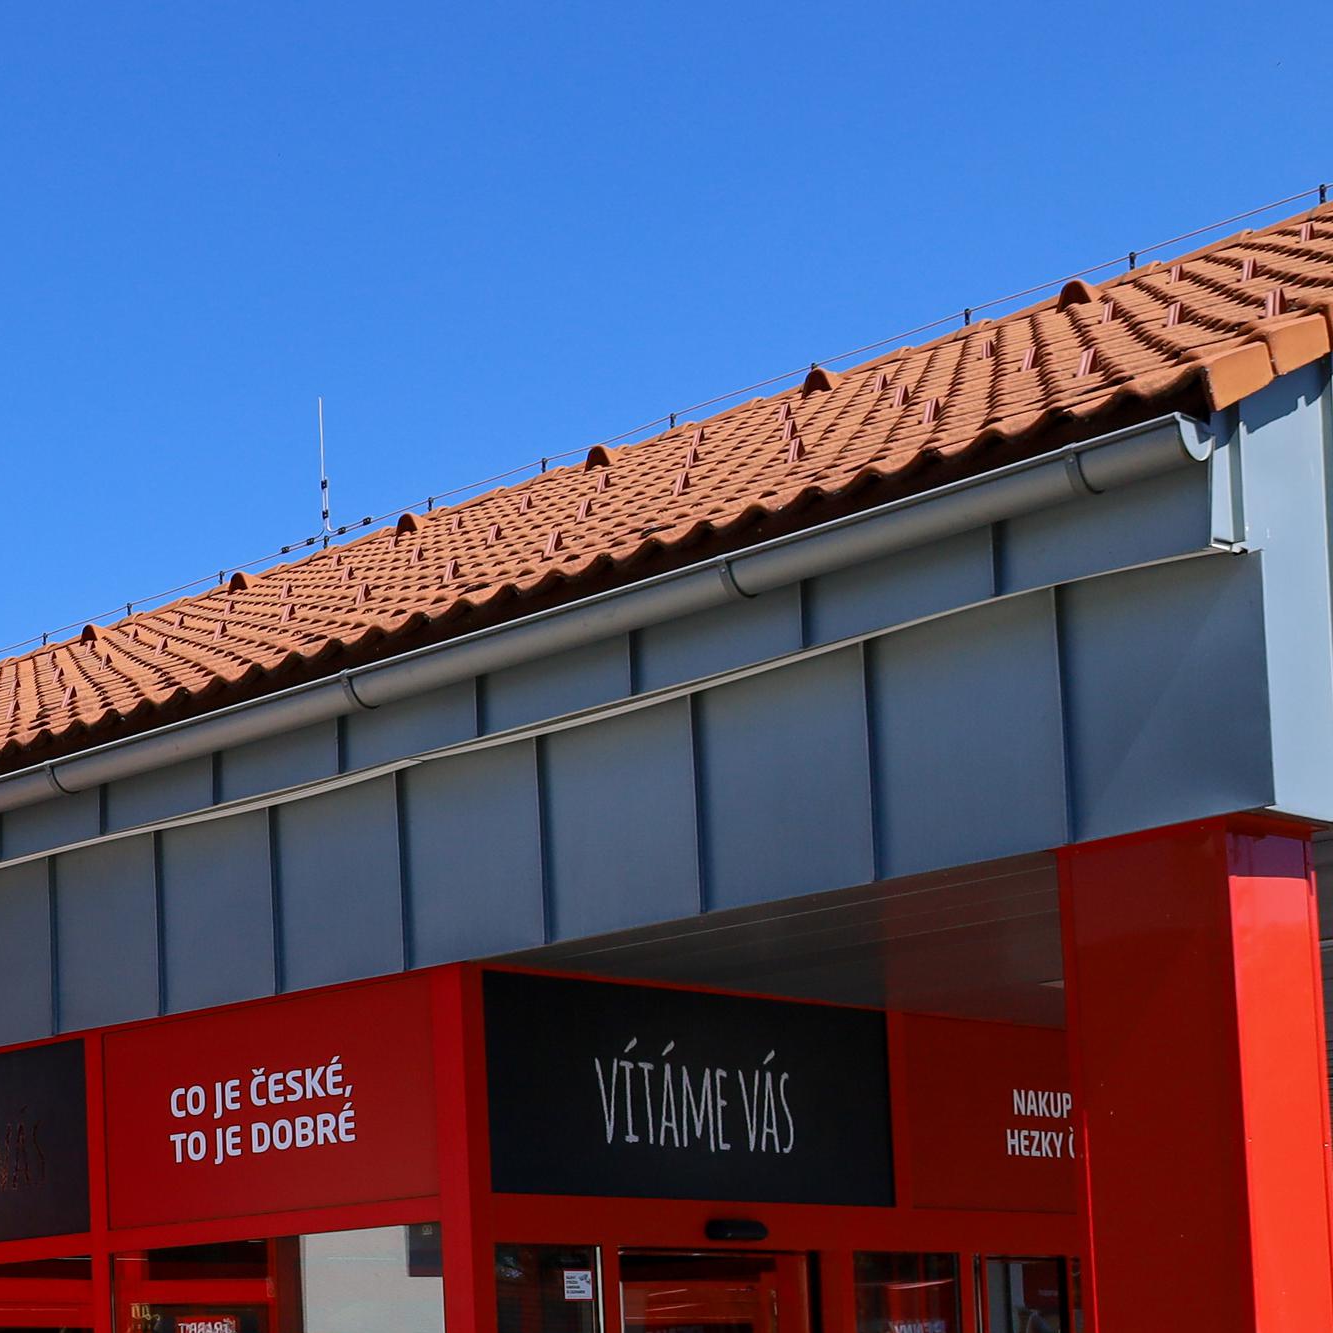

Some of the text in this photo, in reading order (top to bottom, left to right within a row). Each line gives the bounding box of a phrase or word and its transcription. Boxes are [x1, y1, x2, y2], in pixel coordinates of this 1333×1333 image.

[170, 1055, 353, 1119] CO JE ČESKÉ,
[595, 1037, 795, 1154] VÍTÁME VÁS
[1013, 1089, 1072, 1119] NAKUP
[169, 1102, 356, 1165] TO JE DOBRÉ
[1006, 1128, 1064, 1158] HEZKY
